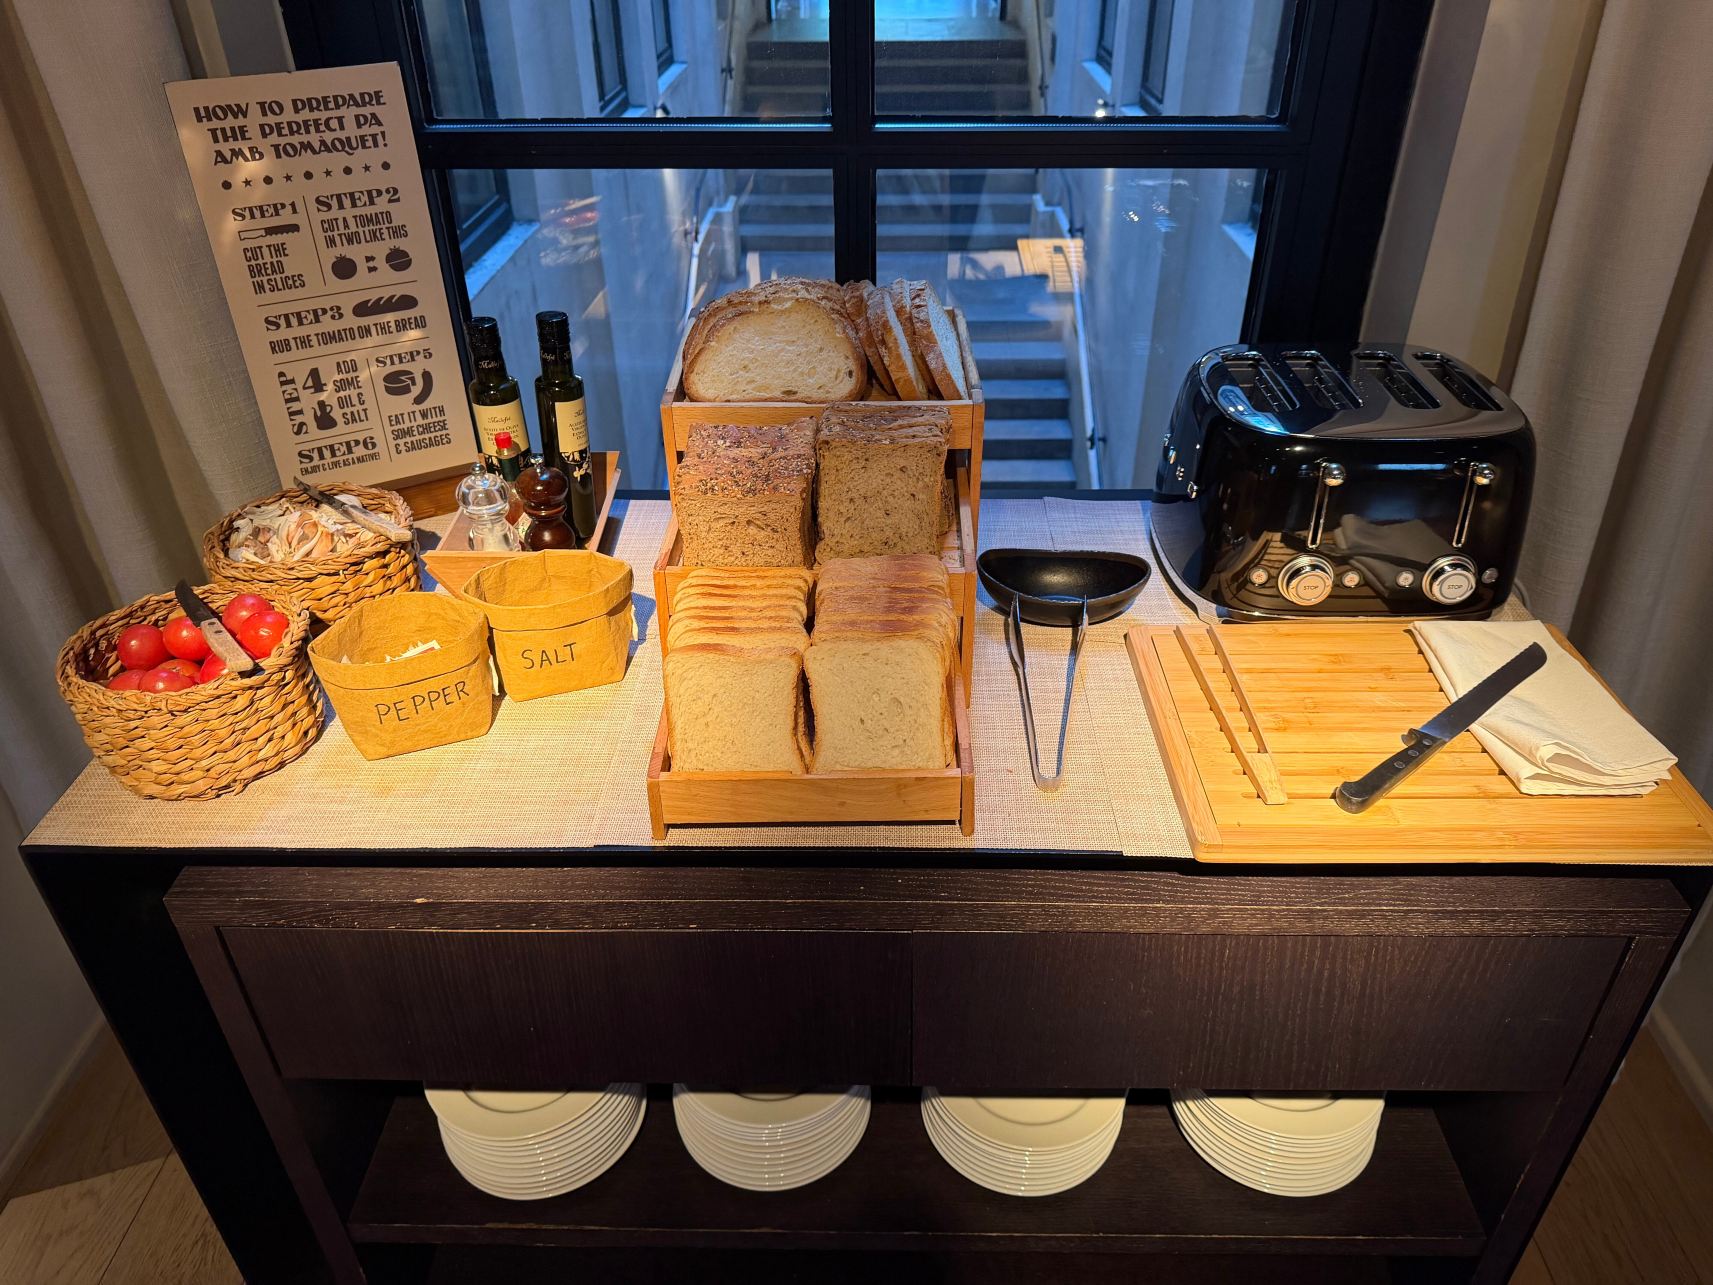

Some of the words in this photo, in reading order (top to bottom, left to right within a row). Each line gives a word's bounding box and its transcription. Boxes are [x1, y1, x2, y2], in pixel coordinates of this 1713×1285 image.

[193, 102, 249, 123] HOW
[256, 100, 284, 117] TO
[291, 90, 386, 114] PREPARE
[207, 125, 252, 144] THE
[259, 116, 345, 139] PERFECT
[354, 112, 383, 129] PA
[213, 146, 264, 166] AMB
[270, 131, 388, 159] TOMÀQUET!
[320, 218, 340, 233] CUT
[342, 217, 350, 231] A
[352, 211, 393, 229] TOMATO
[324, 234, 337, 249] IN
[337, 230, 361, 247] TWO
[363, 227, 385, 243] LIKE
[385, 224, 408, 240] THIS
[243, 245, 265, 262] CUT
[265, 242, 289, 259] THE
[247, 260, 285, 279] BREAD
[252, 279, 266, 295] IN
[266, 273, 306, 293] SLICES
[268, 338, 292, 355] RUB
[292, 334, 314, 350] THE
[314, 327, 356, 346] TOMATO
[357, 325, 372, 339] ON
[373, 320, 393, 336] THE
[394, 314, 427, 333] BREAD
[335, 358, 358, 376] ADD
[332, 375, 362, 393] SOME
[277, 370, 309, 436] STEP
[302, 366, 329, 395] 4
[336, 394, 356, 410] OIL
[341, 408, 369, 426] SALT
[387, 412, 406, 427] EAT
[407, 410, 417, 423] IT
[418, 404, 446, 421] WITH
[391, 425, 416, 441] SOME
[416, 419, 449, 436] CHEESE
[403, 433, 452, 453] SAUSAGES
[300, 463, 321, 476] ENJOY
[327, 459, 343, 471] LIVE
[342, 458, 352, 467] AS
[351, 457, 357, 465] A
[356, 451, 381, 464] NATIVE!
[521, 642, 577, 670] SALT
[375, 681, 470, 725] PEPPER
